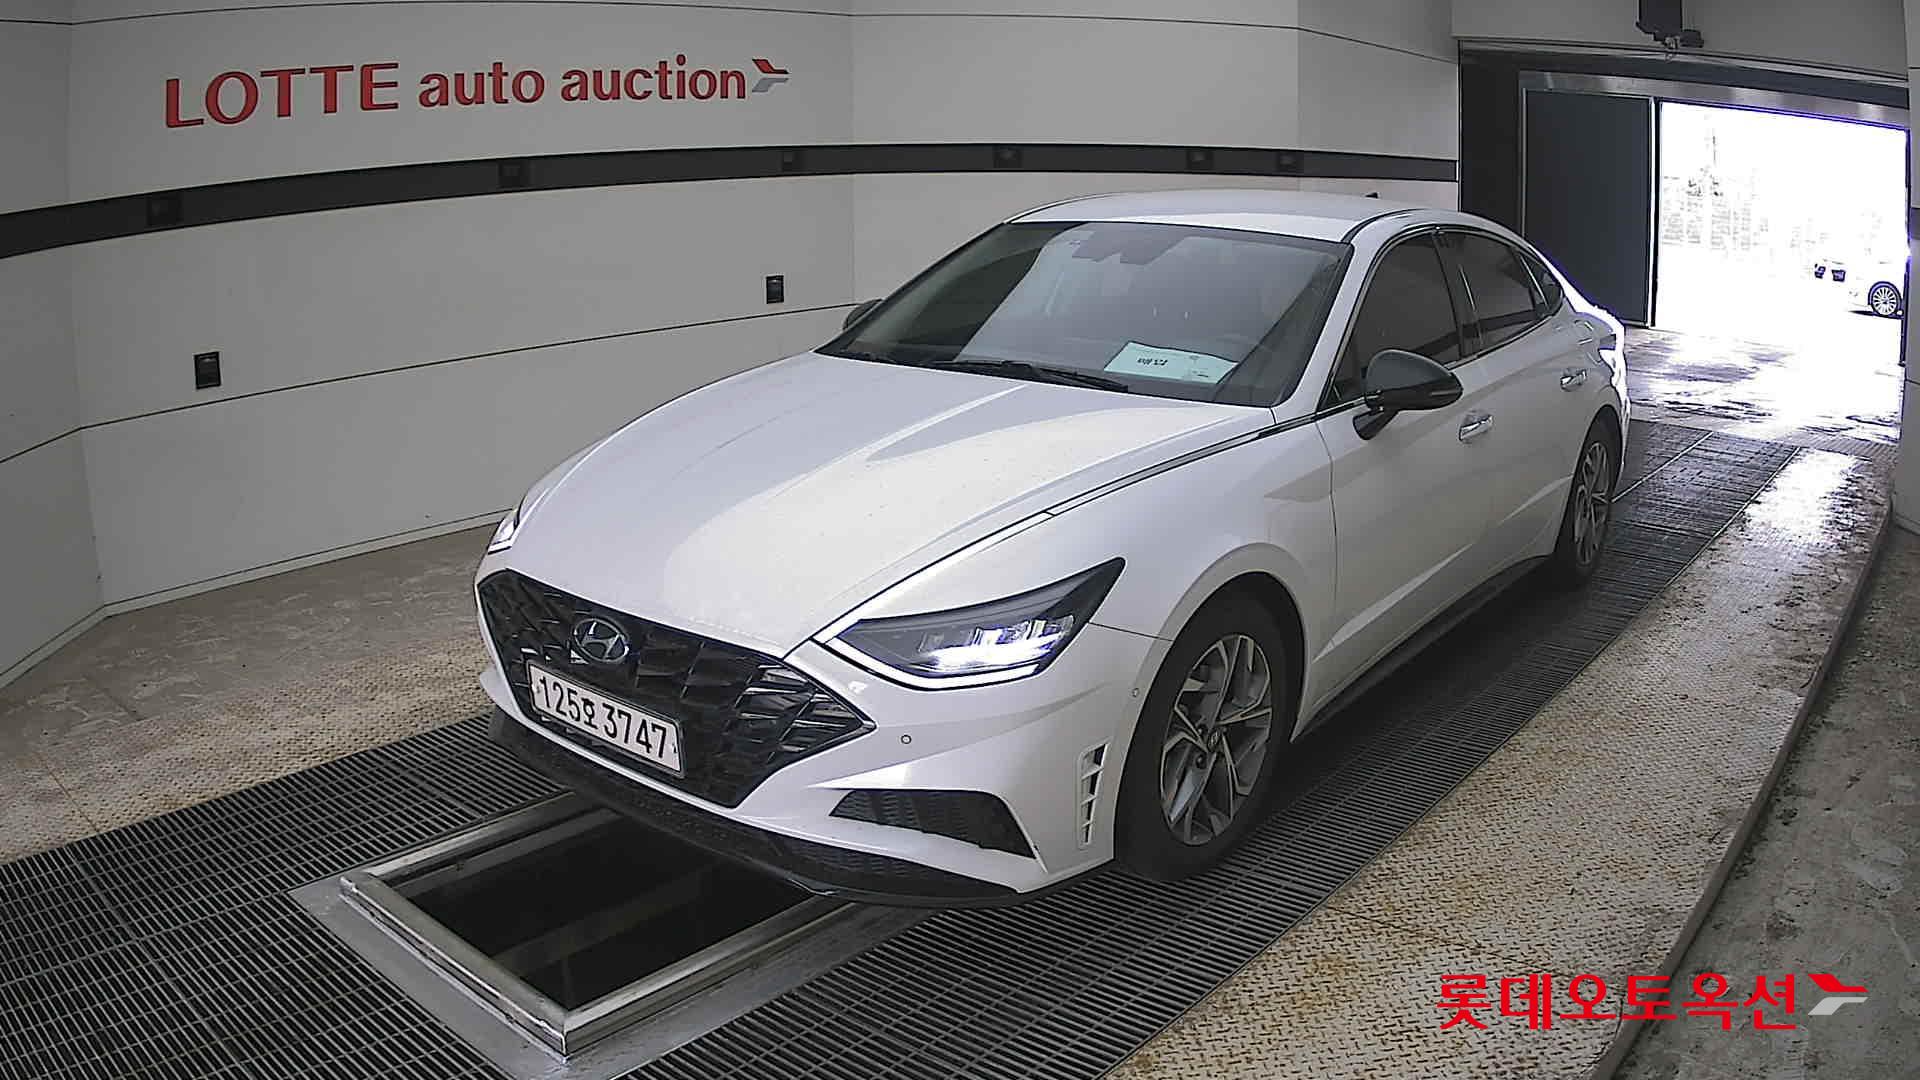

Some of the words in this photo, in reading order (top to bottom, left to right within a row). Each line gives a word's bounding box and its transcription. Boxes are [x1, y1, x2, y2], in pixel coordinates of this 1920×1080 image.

[165, 63, 399, 128] LOTTE
[418, 61, 546, 108] auto
[560, 54, 747, 102] auction
[602, 702, 667, 759] 3747
